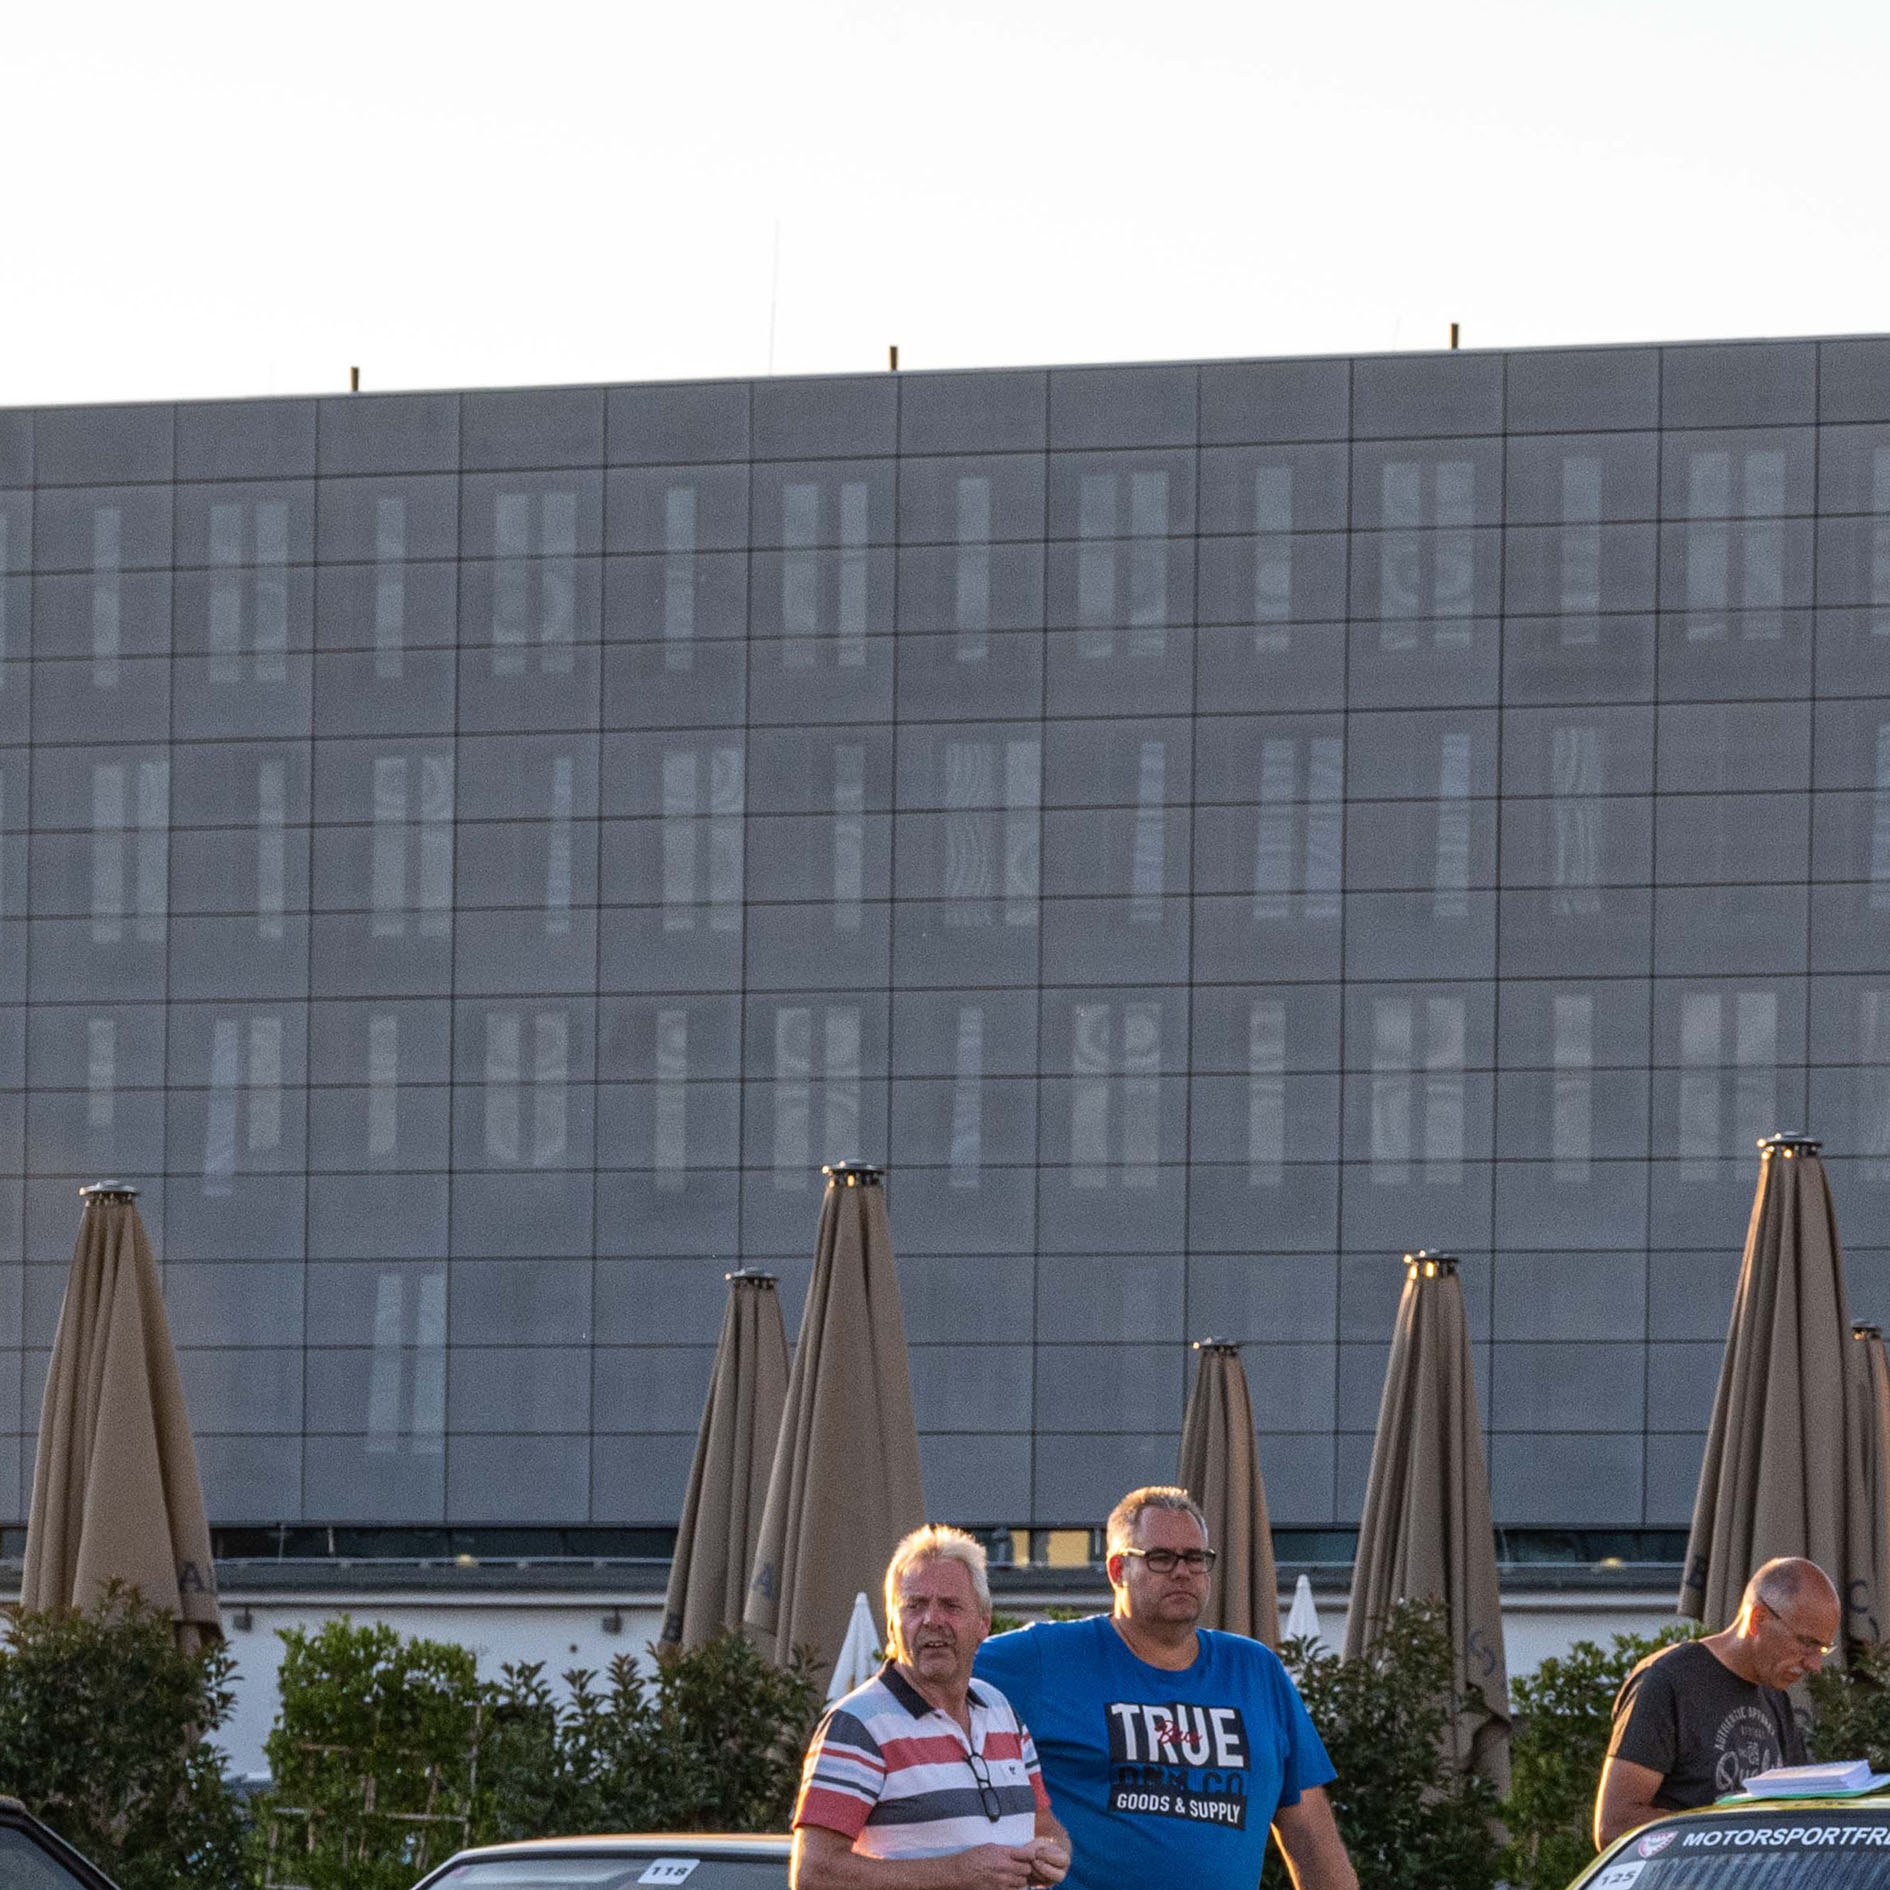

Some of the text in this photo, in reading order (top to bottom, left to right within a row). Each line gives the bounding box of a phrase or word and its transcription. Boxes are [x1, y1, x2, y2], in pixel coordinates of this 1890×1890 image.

[1111, 1703, 1244, 1768] TRUE
[1117, 1793, 1241, 1824] GOODS & SUPPLY
[651, 1866, 689, 1877] 118
[1600, 1871, 1637, 1886] 125
